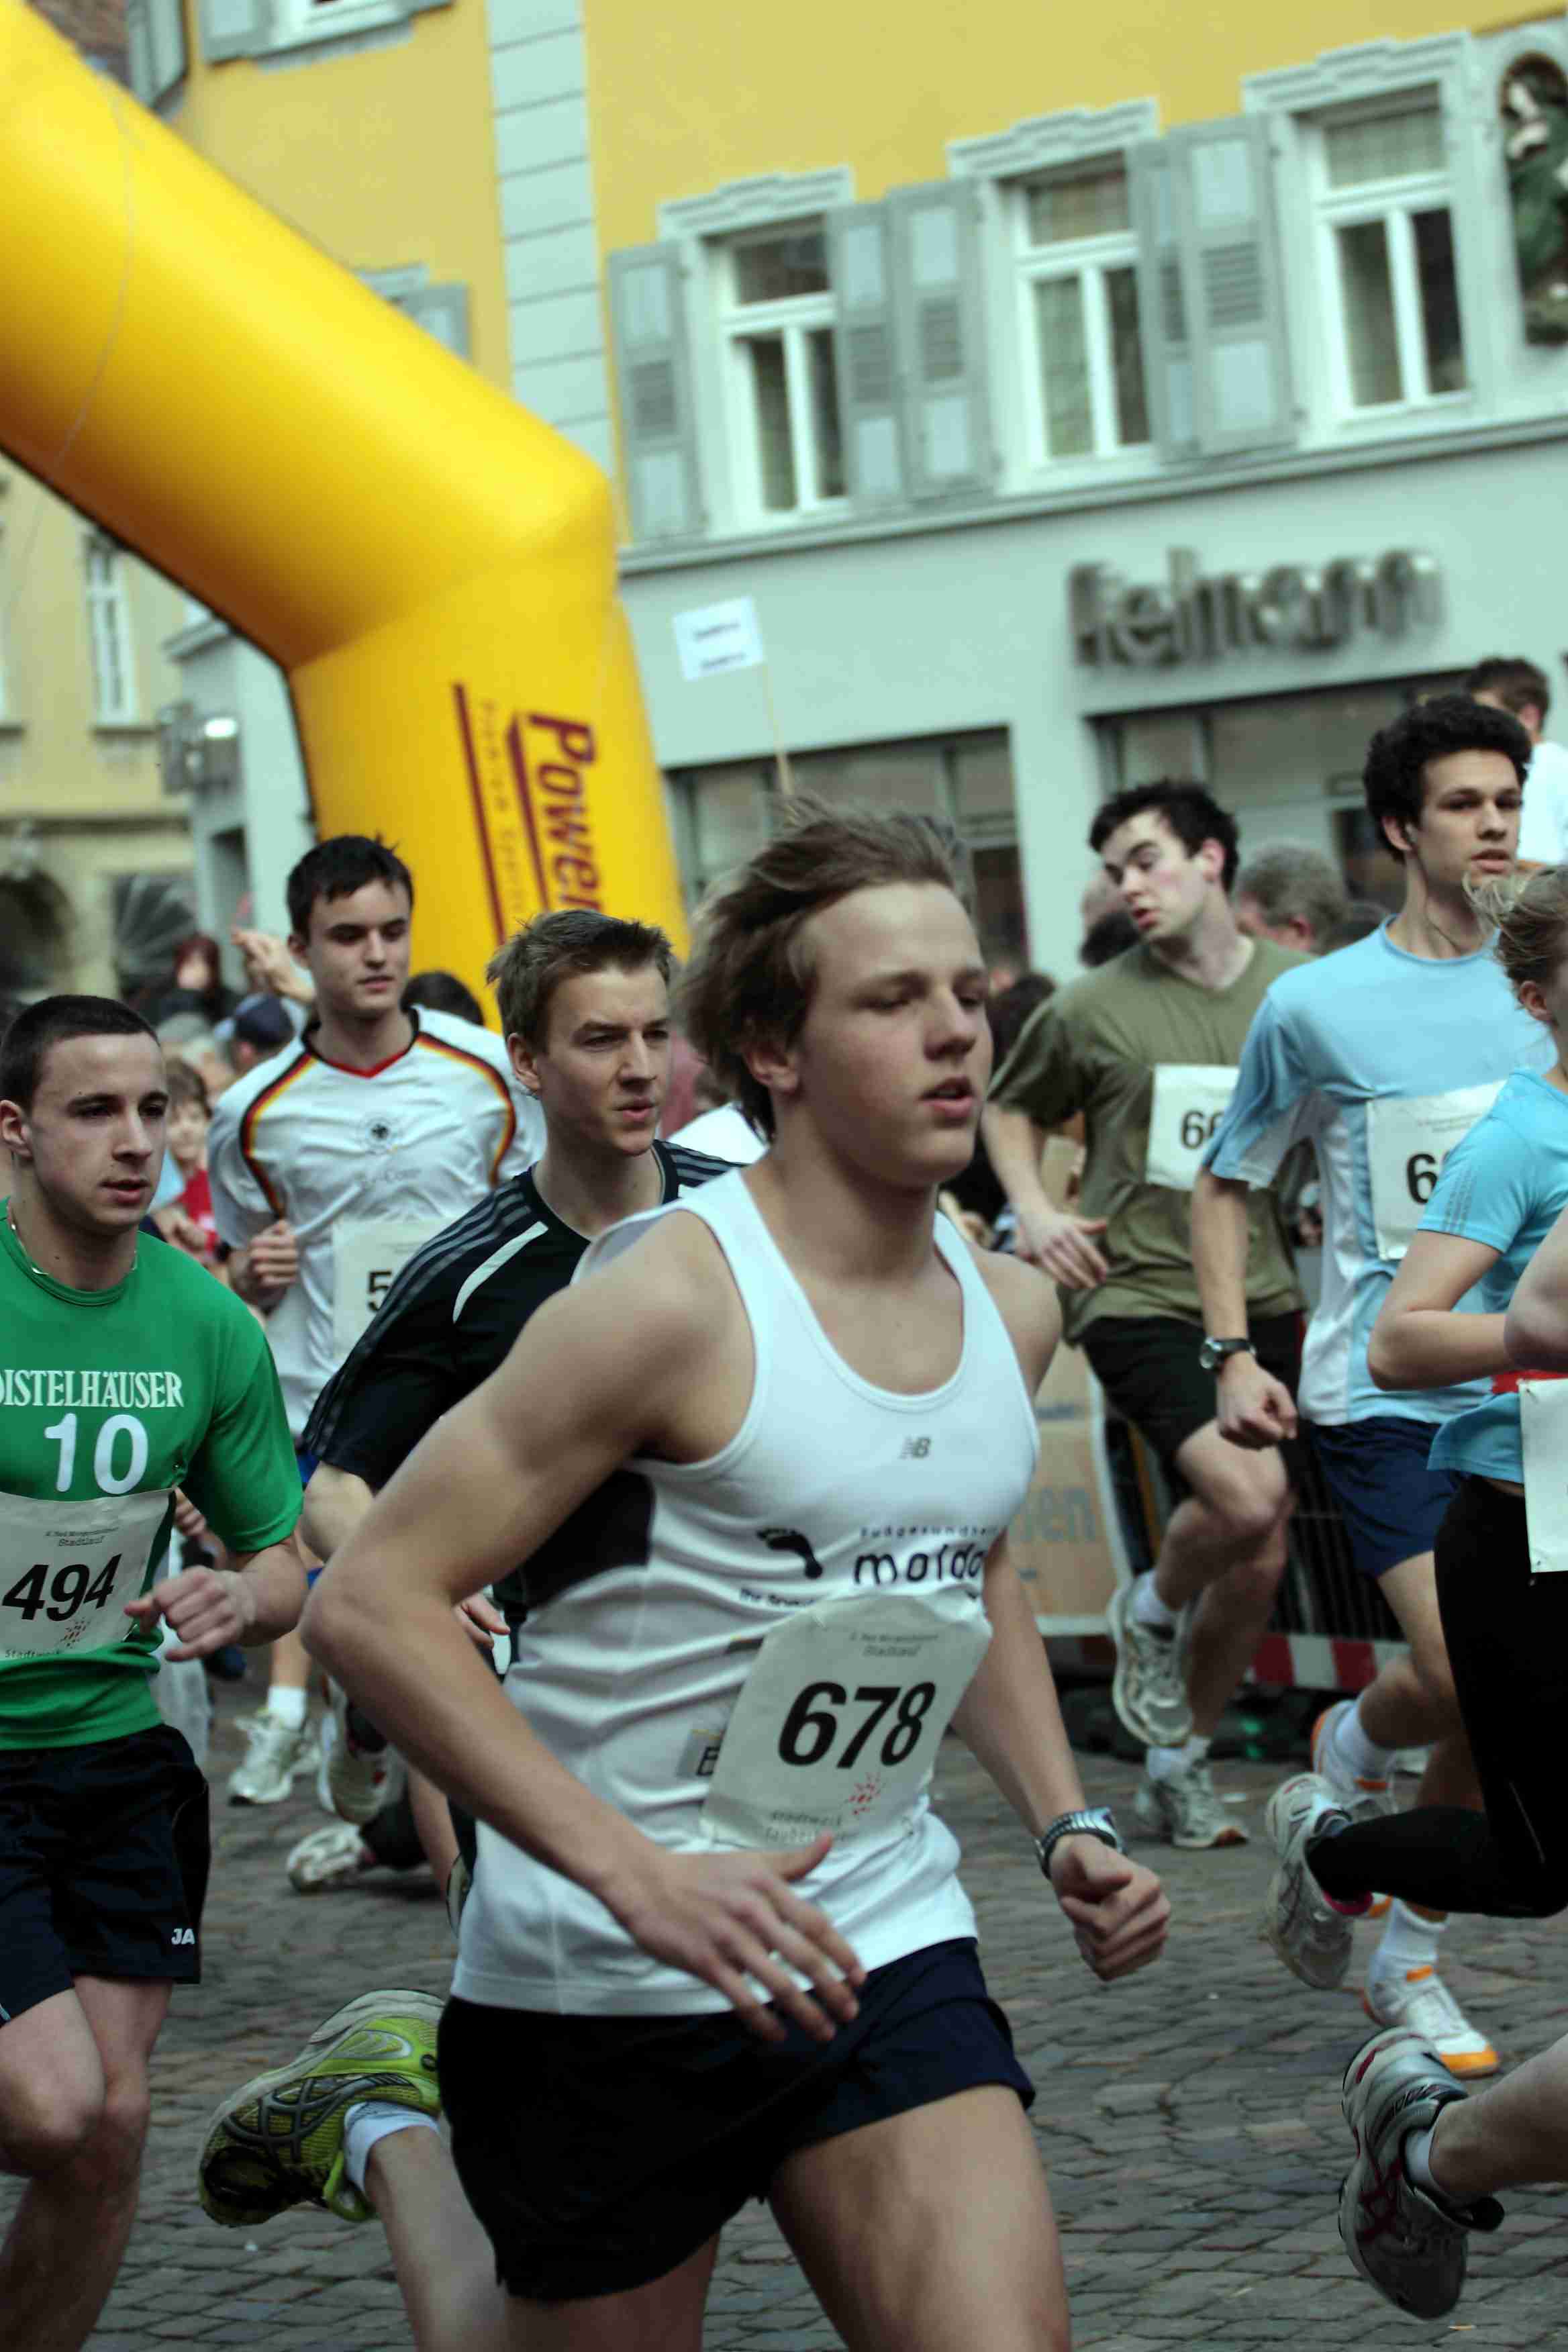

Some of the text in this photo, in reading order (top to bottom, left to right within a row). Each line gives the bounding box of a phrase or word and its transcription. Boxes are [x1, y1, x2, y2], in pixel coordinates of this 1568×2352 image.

[44, 1413, 149, 1495] 10
[2, 1554, 121, 1622] 494
[779, 1681, 937, 1769] 678
